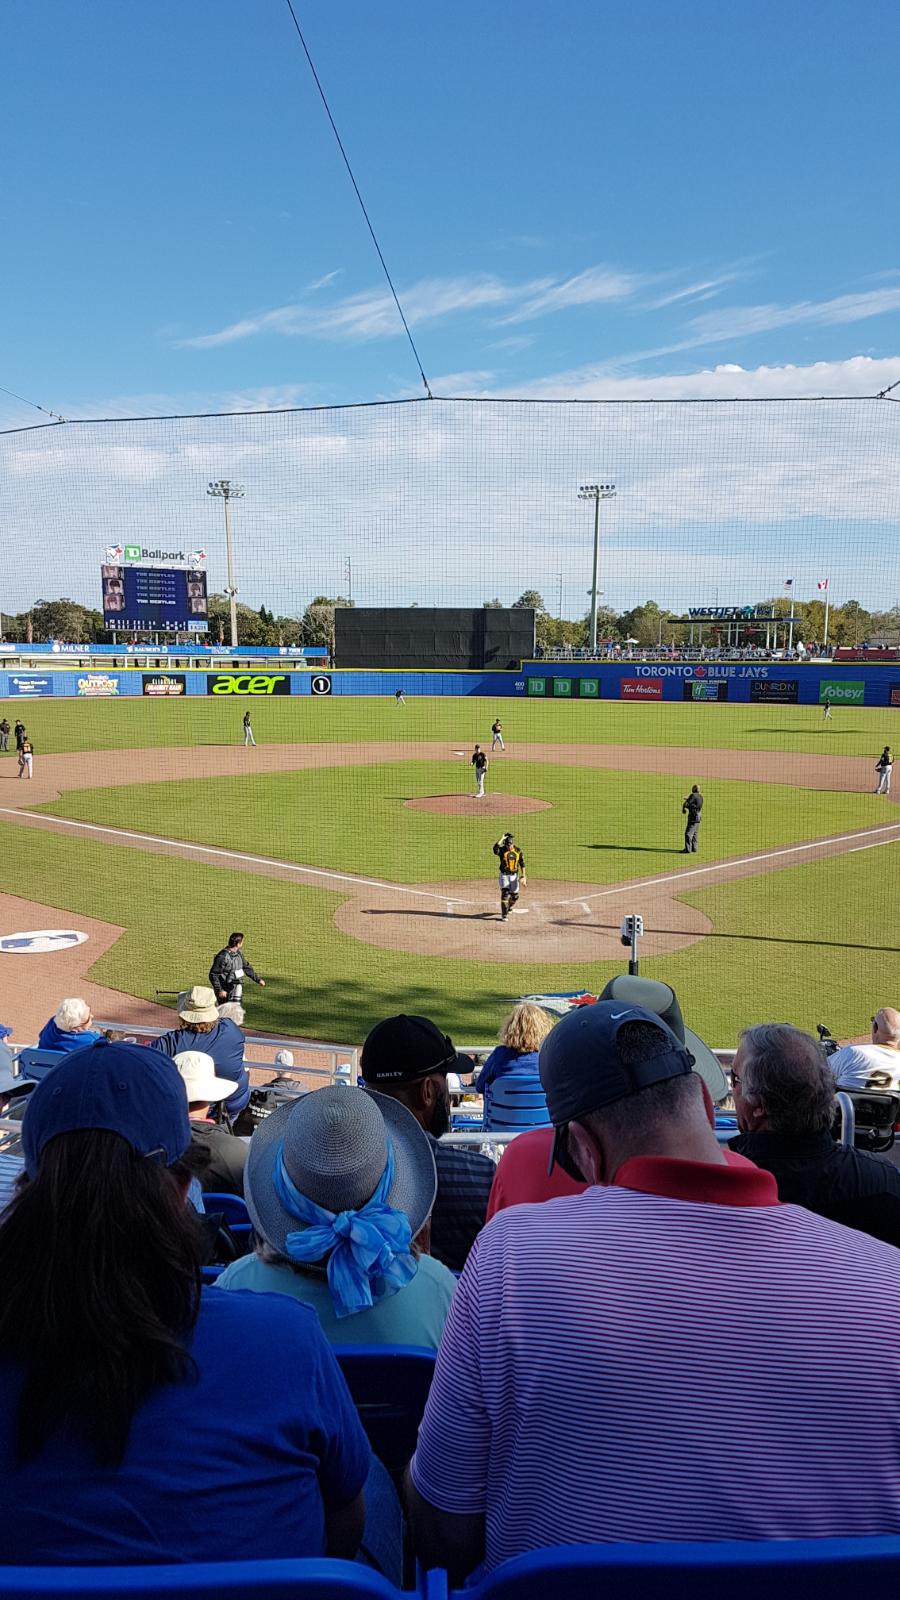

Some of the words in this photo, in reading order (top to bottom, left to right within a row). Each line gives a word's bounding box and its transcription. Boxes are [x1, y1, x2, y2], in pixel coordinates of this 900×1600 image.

[142, 549, 185, 560] Ballpark
[688, 607, 740, 617] WESTJET
[635, 666, 693, 677] TORONTO
[708, 667, 736, 677] BLUE
[738, 667, 768, 678] JAYS
[78, 678, 118, 688] OUTPOST
[212, 676, 285, 694] acer
[532, 681, 543, 692] TD
[556, 682, 568, 692] TD
[582, 682, 596, 693] TD
[624, 684, 634, 693] Tim
[636, 685, 660, 694] Hortons
[820, 686, 863, 699] Sobeys
